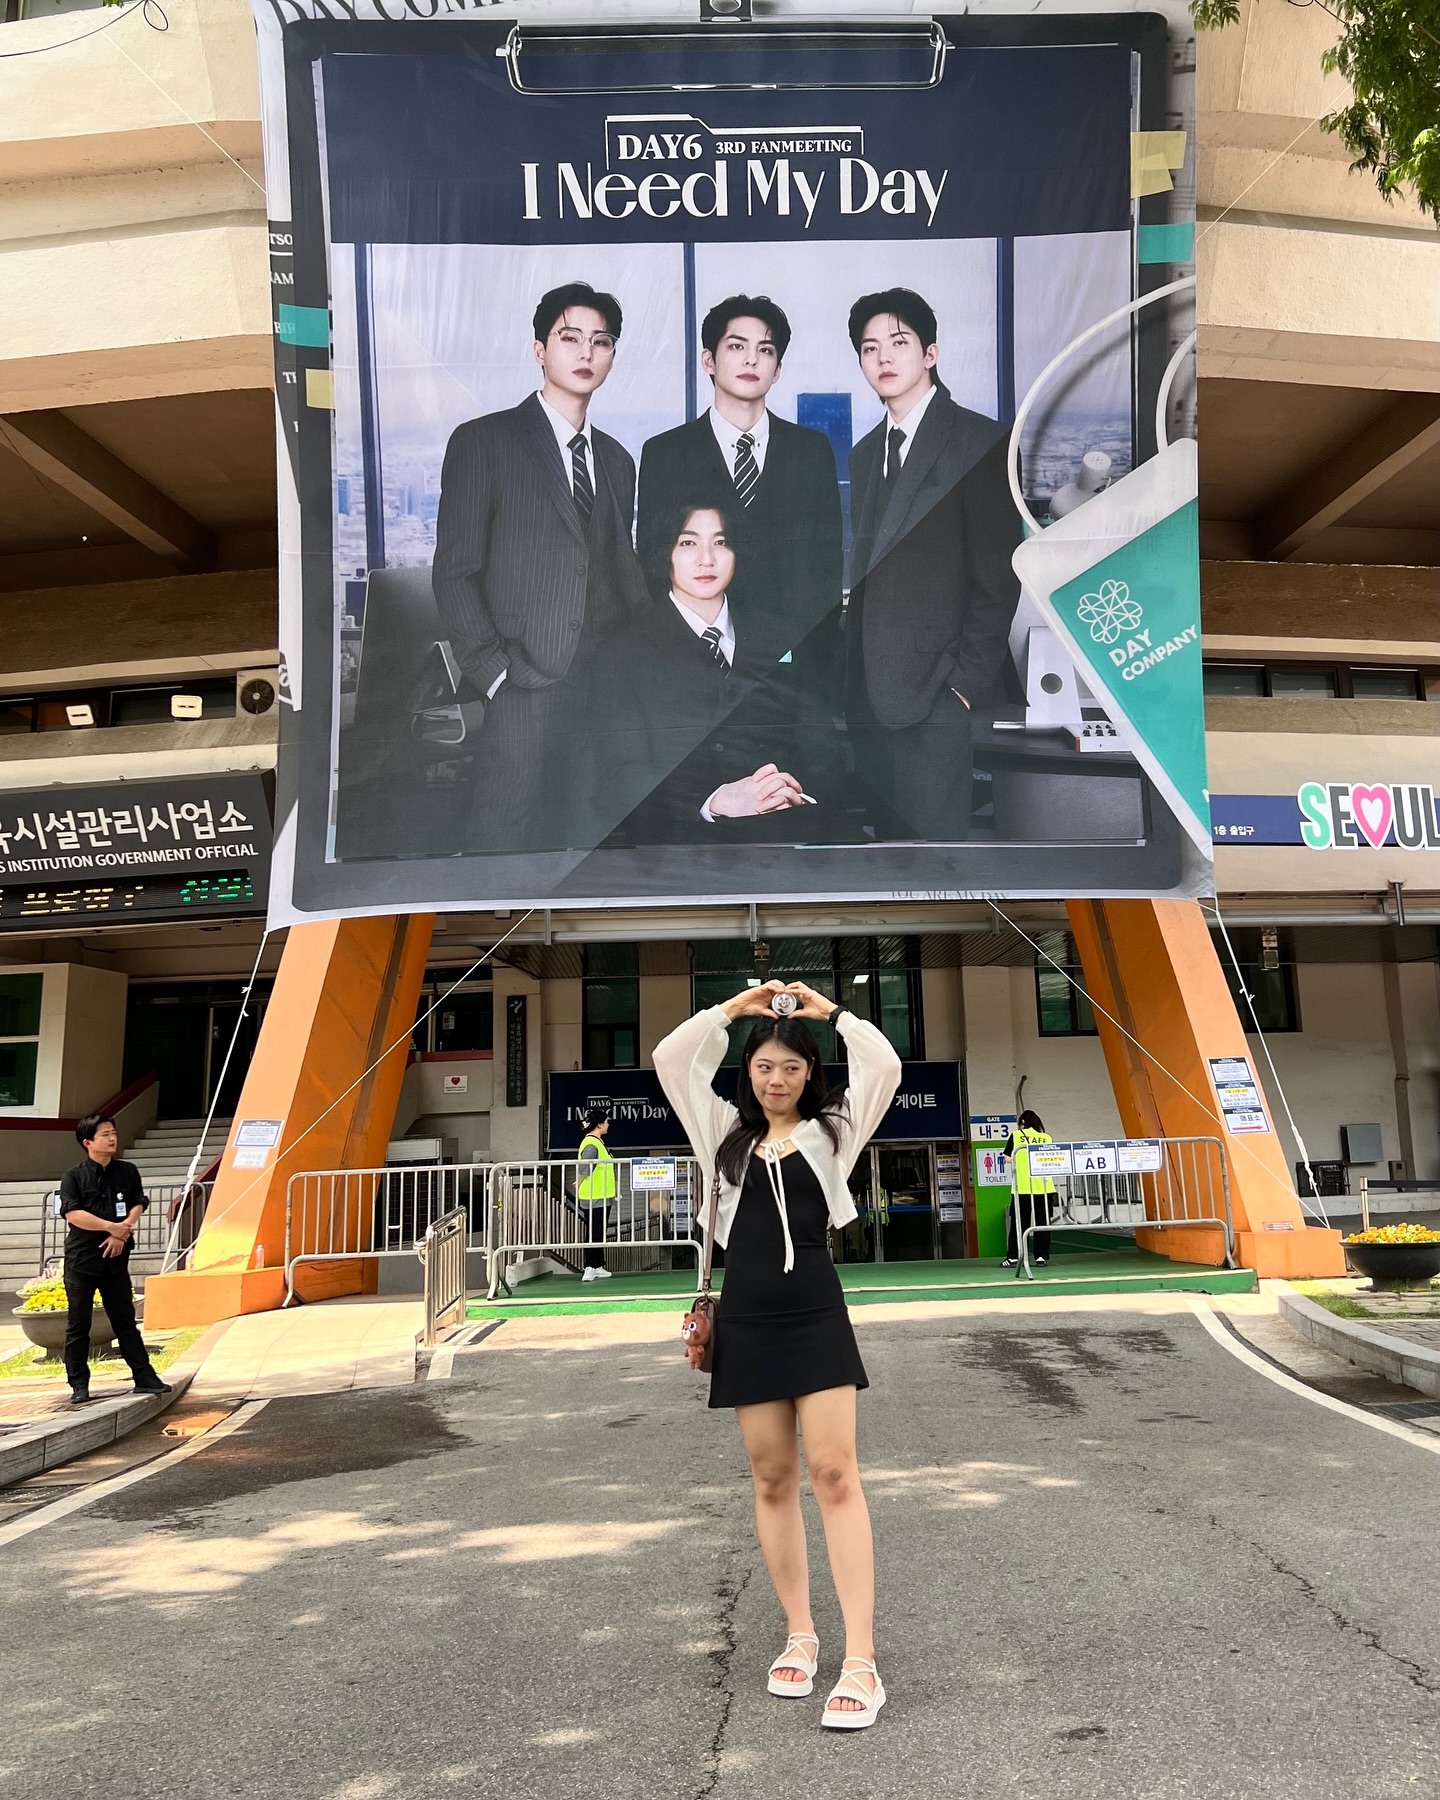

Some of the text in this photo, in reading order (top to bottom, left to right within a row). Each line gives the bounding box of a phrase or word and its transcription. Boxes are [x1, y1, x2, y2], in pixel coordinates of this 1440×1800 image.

[617, 133, 853, 160] DAY6 3RD FANMEETING
[520, 157, 948, 228] I Need My Day
[1108, 628, 1153, 667] DAY
[1121, 624, 1199, 681] COMPANY
[7, 855, 94, 873] INSTITUTION
[95, 847, 192, 867] GOVERNMENT
[195, 843, 259, 860] OFFICIAL
[620, 1105, 640, 1122] My
[642, 1105, 669, 1121] Day
[895, 1093, 937, 1109] 게이트
[985, 1175, 1008, 1183] TOILET
